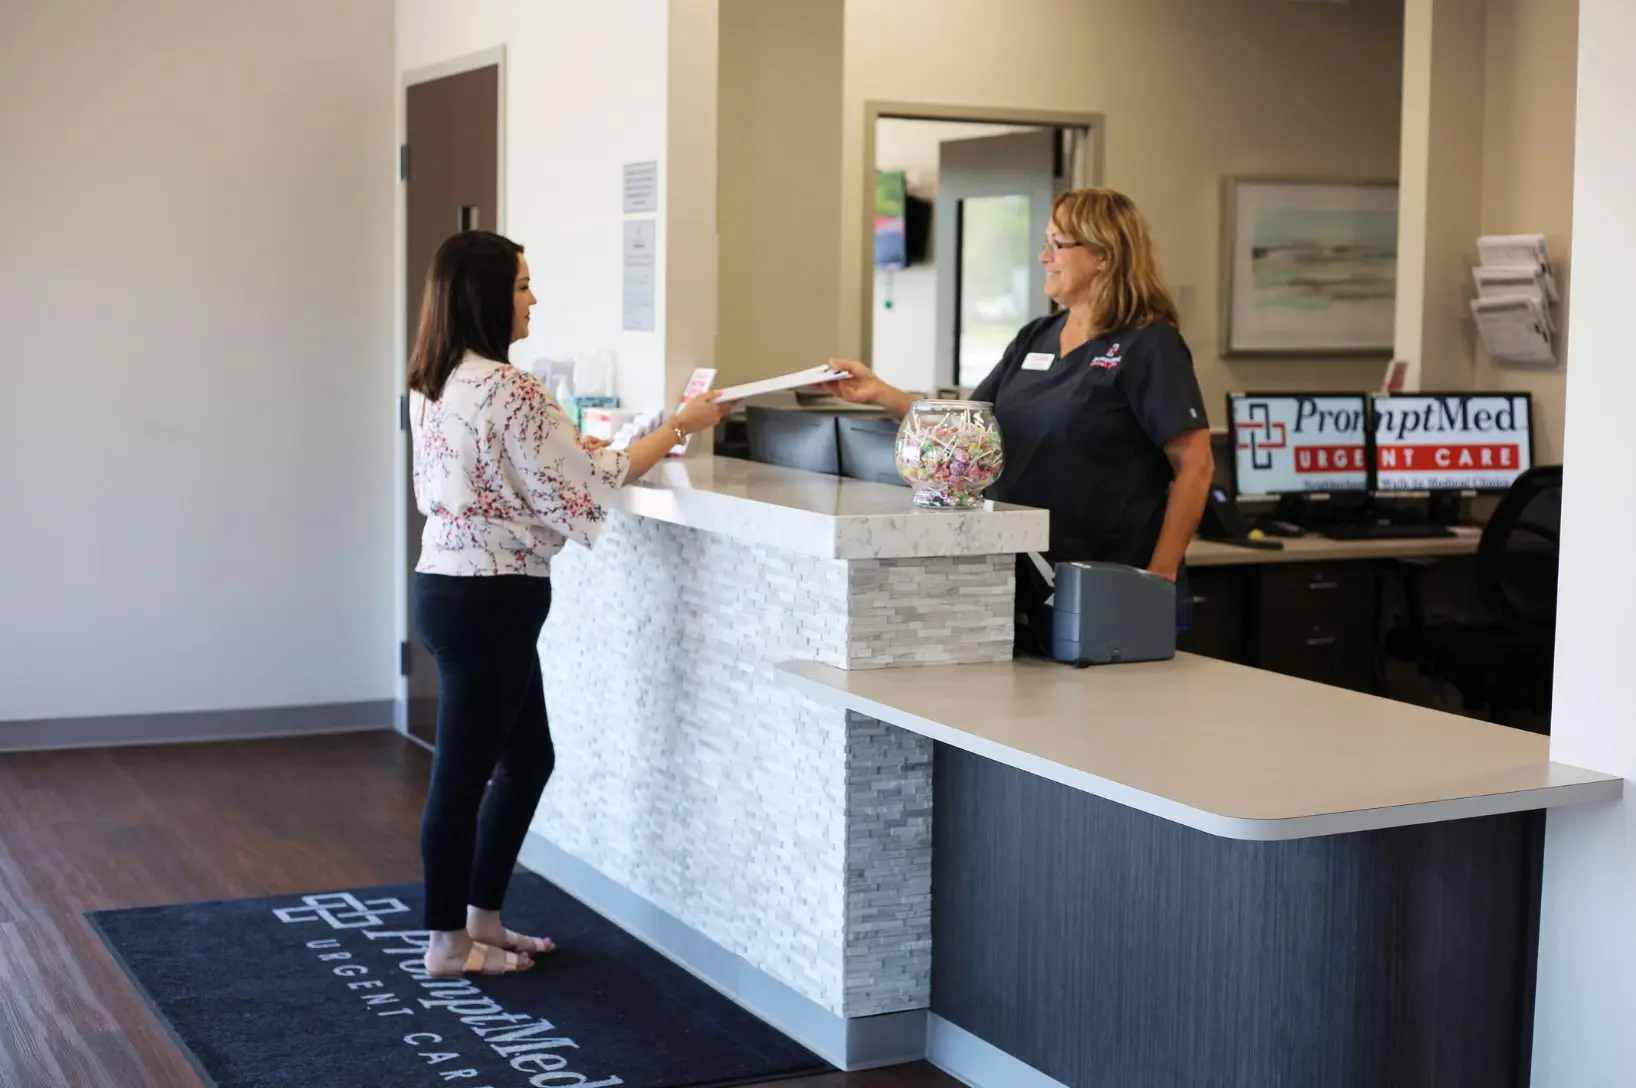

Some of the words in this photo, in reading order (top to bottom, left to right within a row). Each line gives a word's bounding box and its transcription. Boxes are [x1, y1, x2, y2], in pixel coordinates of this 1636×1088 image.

[1299, 448, 1414, 469] URGENT
[1435, 447, 1511, 468] CARE
[306, 938, 415, 1017] URGENT
[403, 1032, 495, 1088] CAR
